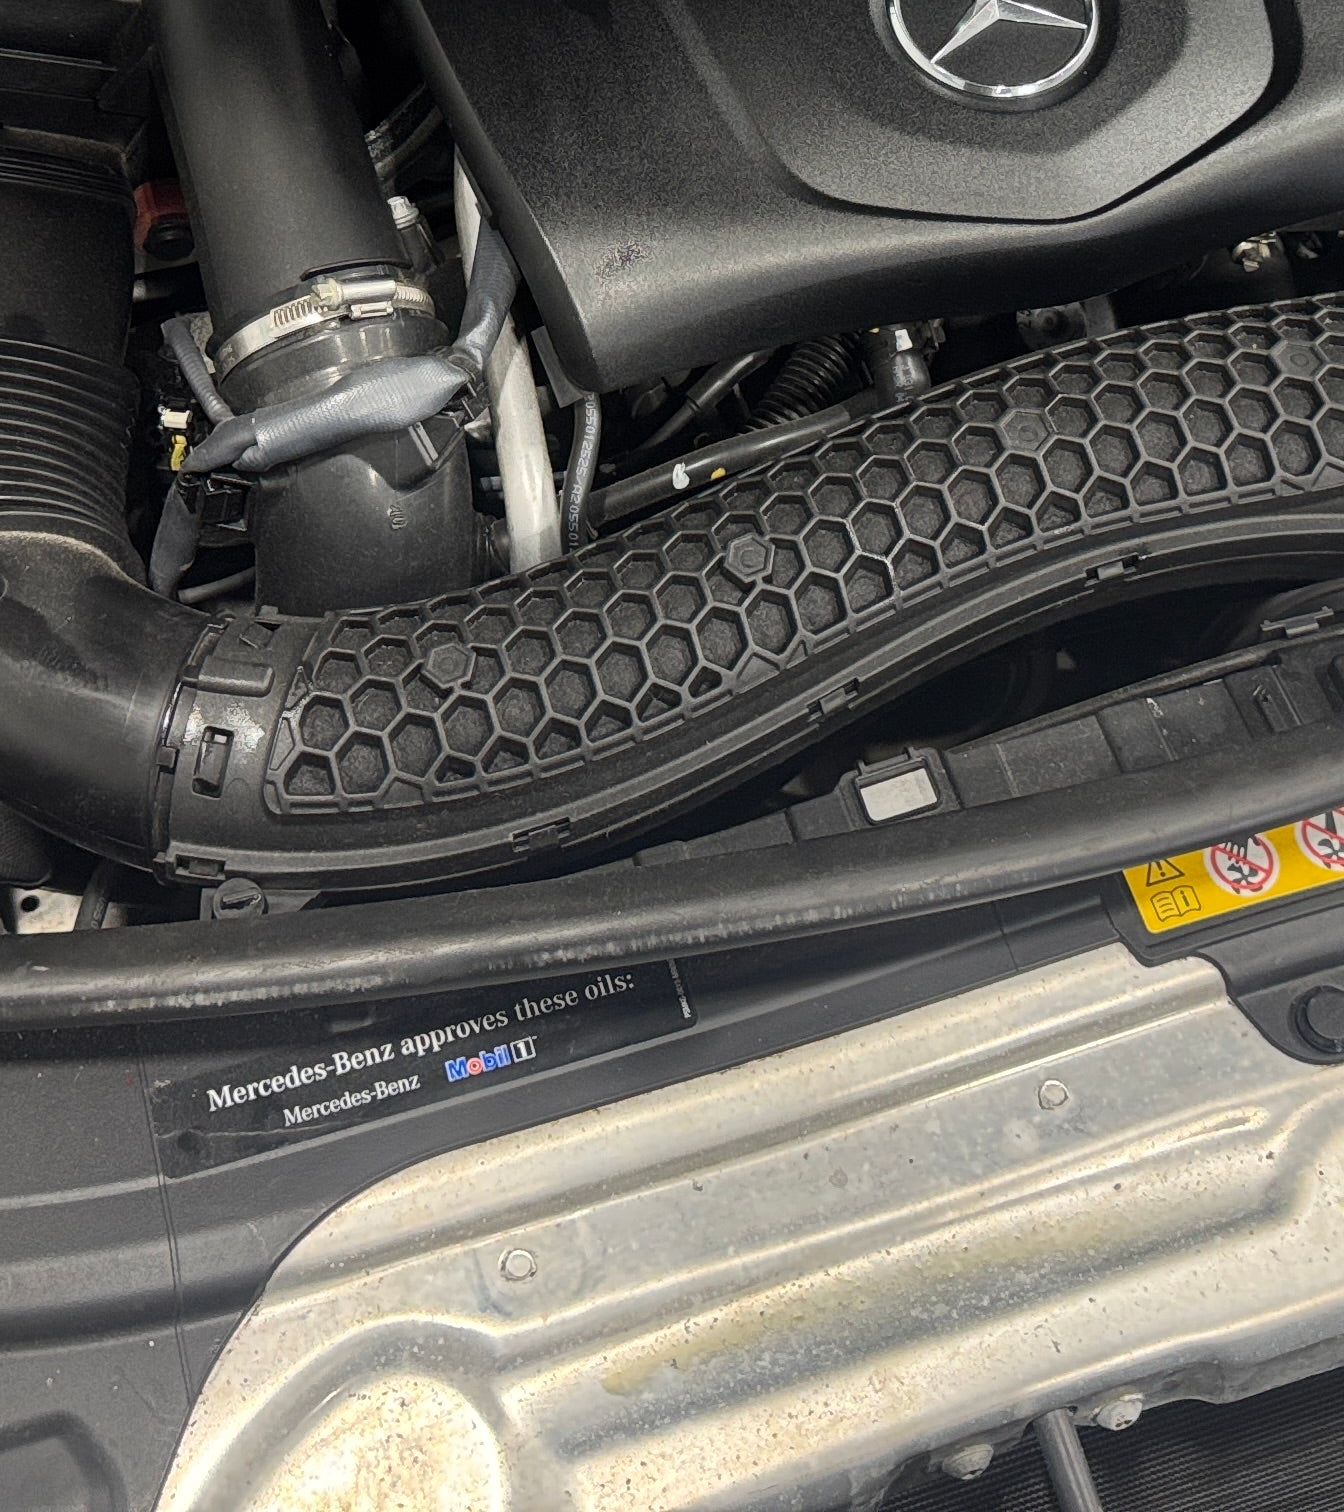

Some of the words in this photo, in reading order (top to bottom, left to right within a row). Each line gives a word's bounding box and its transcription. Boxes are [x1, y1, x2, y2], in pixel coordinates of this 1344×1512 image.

[206, 1042, 396, 1112] Mercedes-Benz
[400, 1009, 509, 1057] approves
[514, 989, 579, 1022] these
[585, 972, 635, 1001] oils:
[444, 1045, 511, 1082] Mobil
[282, 1074, 421, 1128] Mercedes-Benz
